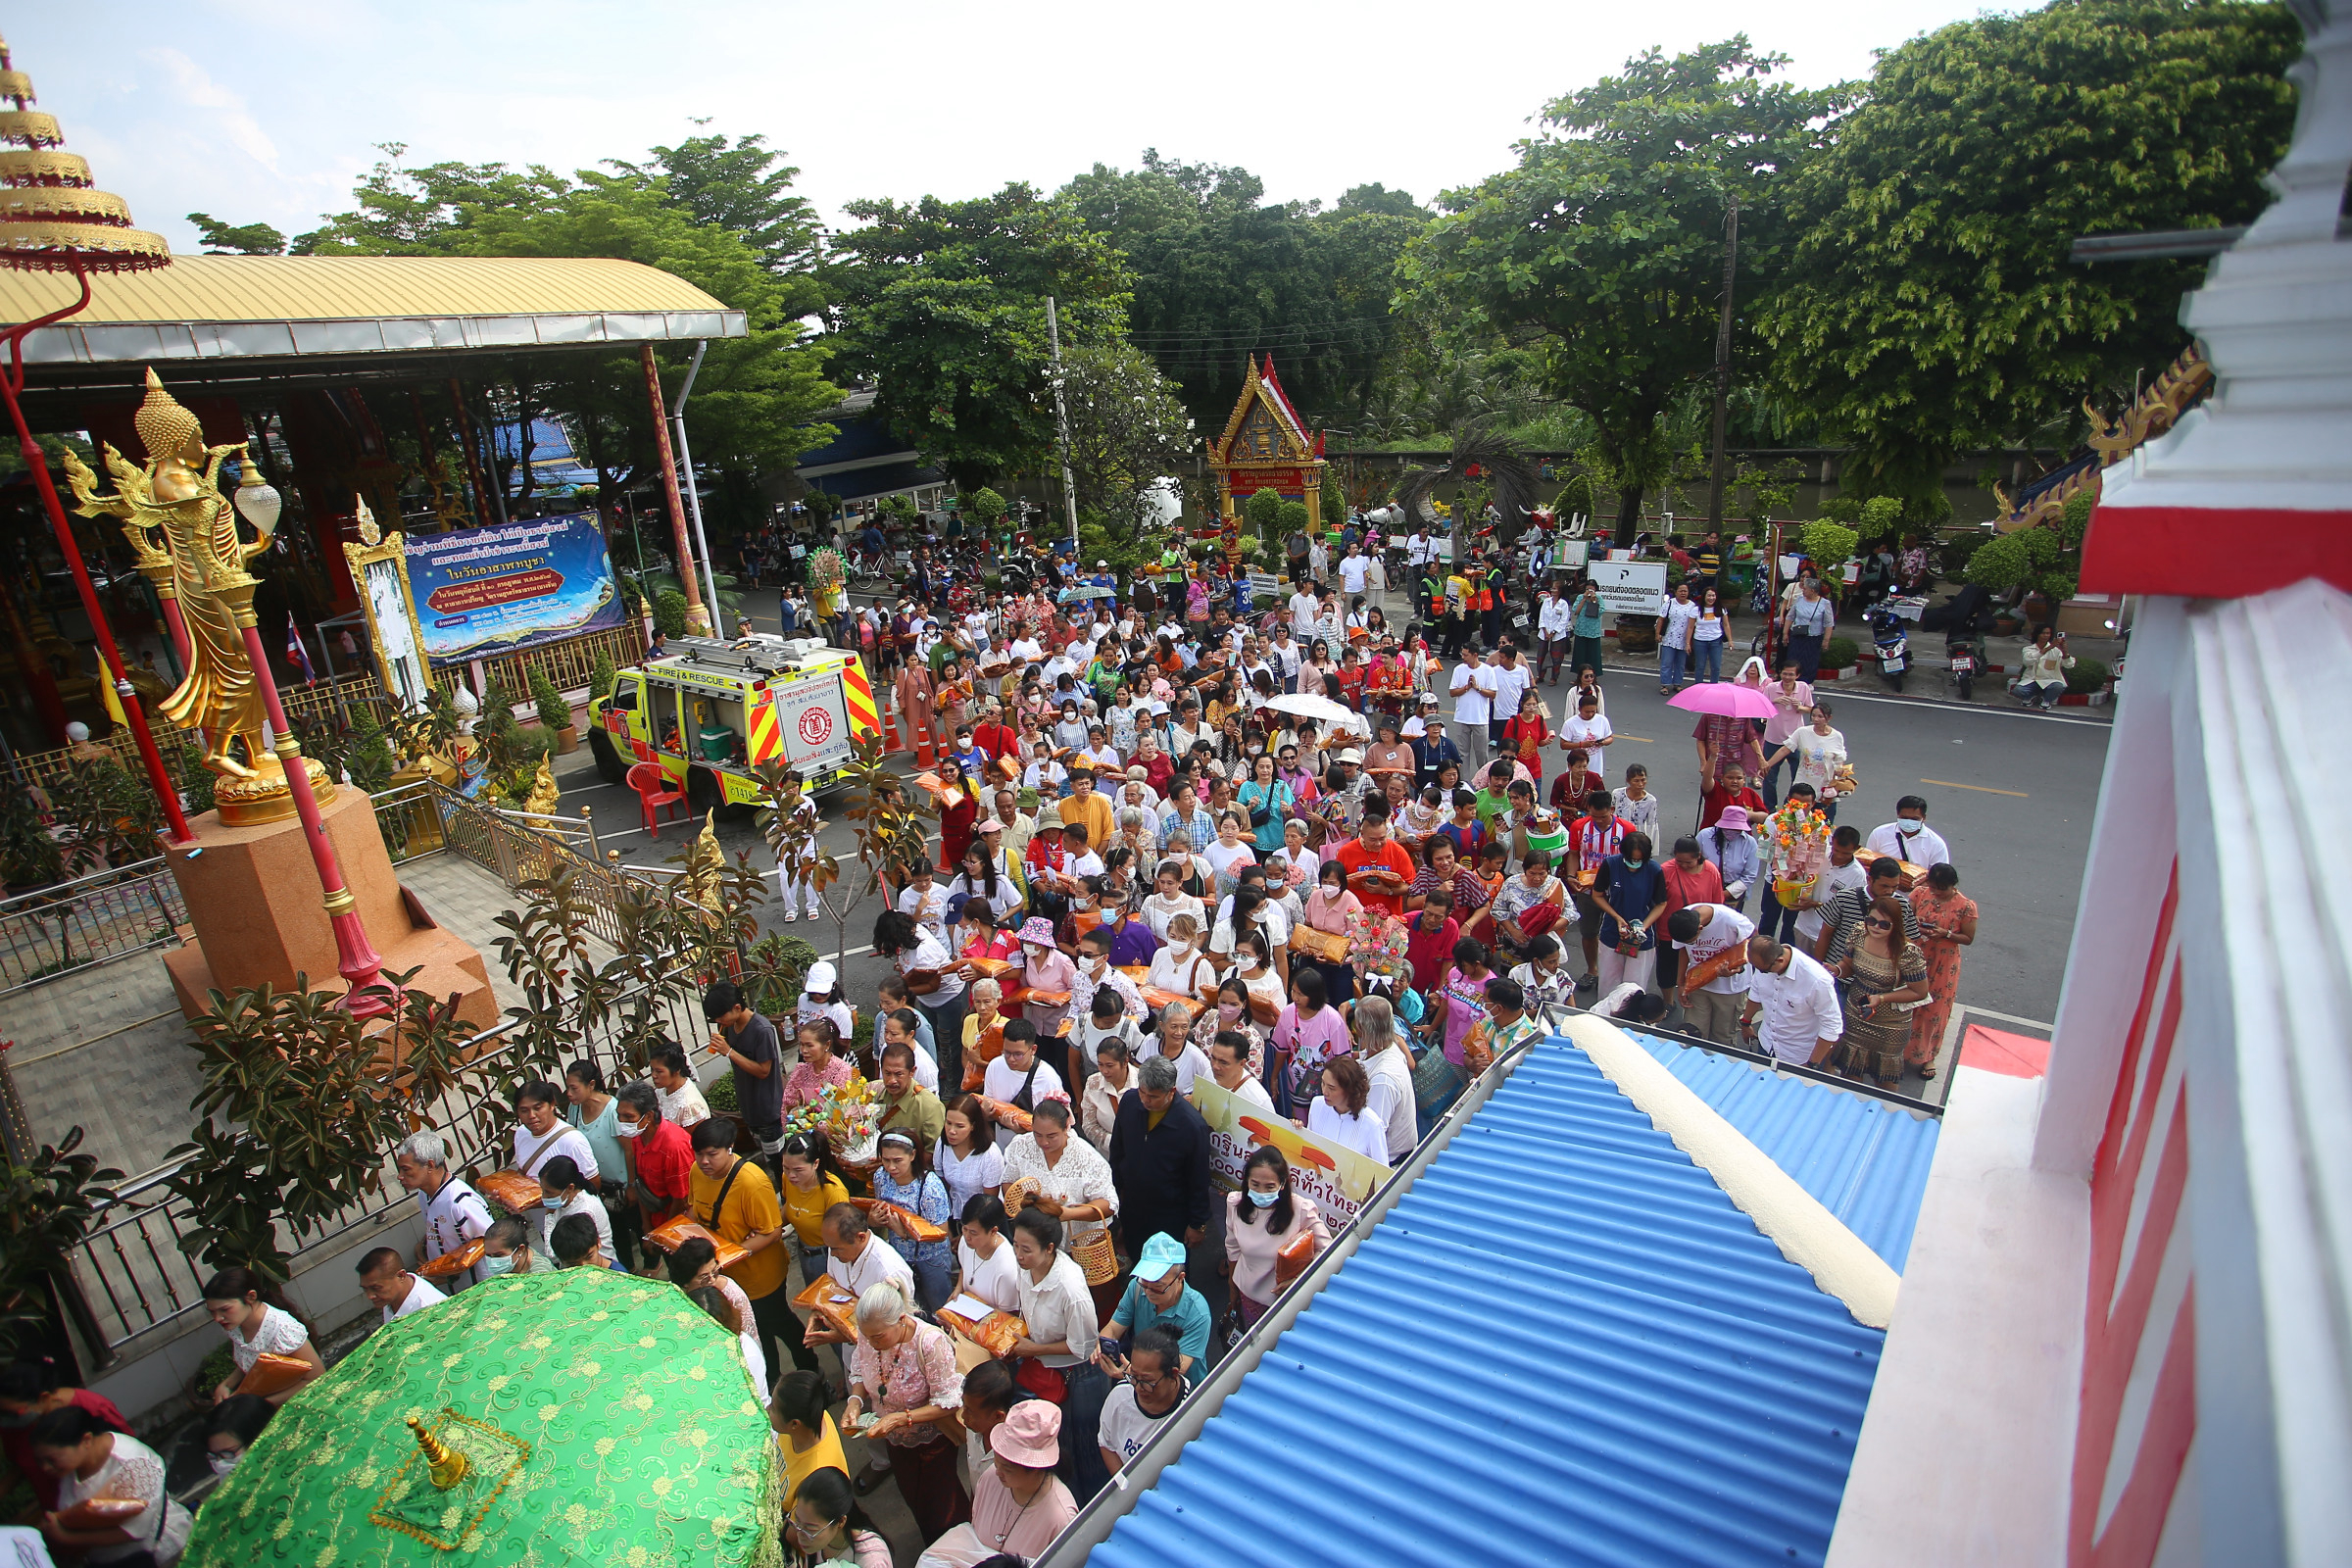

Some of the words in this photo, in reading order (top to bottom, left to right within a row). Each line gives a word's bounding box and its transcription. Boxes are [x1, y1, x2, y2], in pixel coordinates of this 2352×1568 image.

[446, 557, 546, 580] ในวันอาสาฬหบูชา
[659, 667, 676, 678] FIRE
[681, 671, 688, 680] &
[689, 673, 724, 687] RESCUE
[736, 787, 754, 800] 1418
